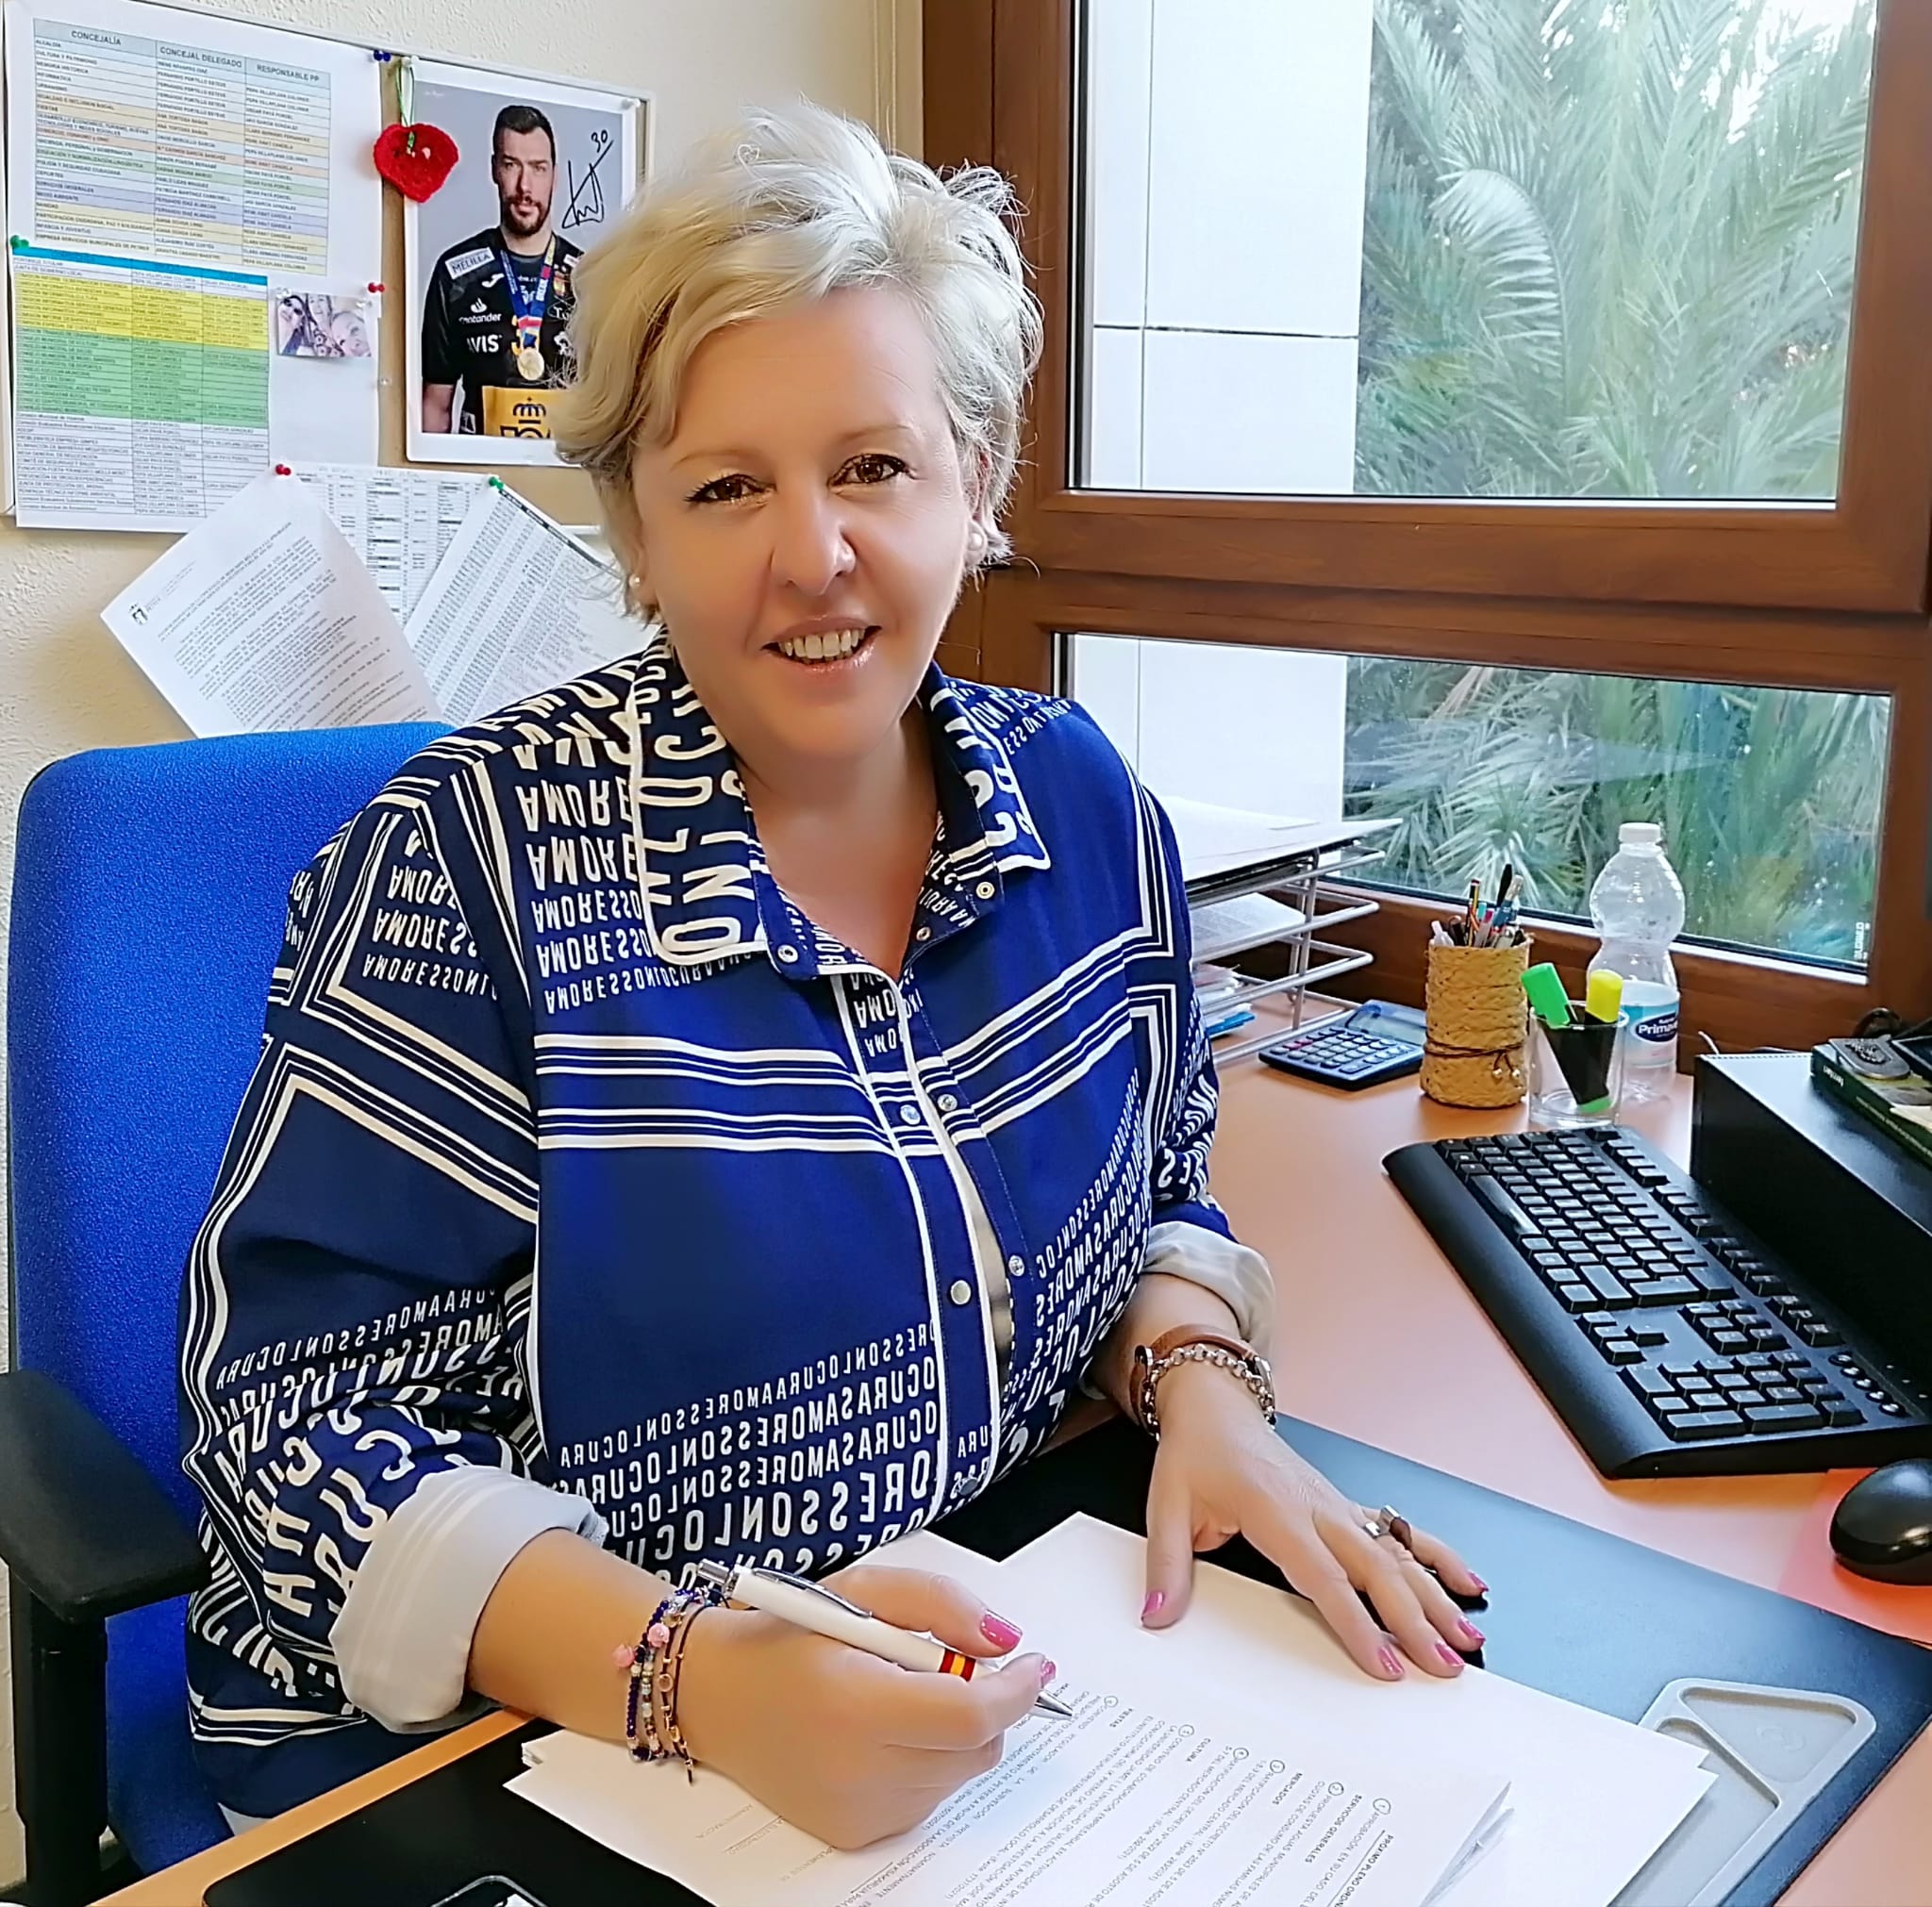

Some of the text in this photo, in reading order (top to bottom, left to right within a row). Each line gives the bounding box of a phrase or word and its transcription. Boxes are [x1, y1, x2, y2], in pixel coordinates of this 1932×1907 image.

[159, 45, 242, 68] CONCEJAL DELEGADO
[256, 63, 308, 80] RESPONSABLE
[591, 129, 609, 153] 30
[452, 254, 491, 274] MELILLA
[1183, 1736, 1212, 1764] CULTURA
[1303, 1793, 1363, 1865] SERVICIOS GENERALES
[1350, 1863, 1373, 1887] PLENO
